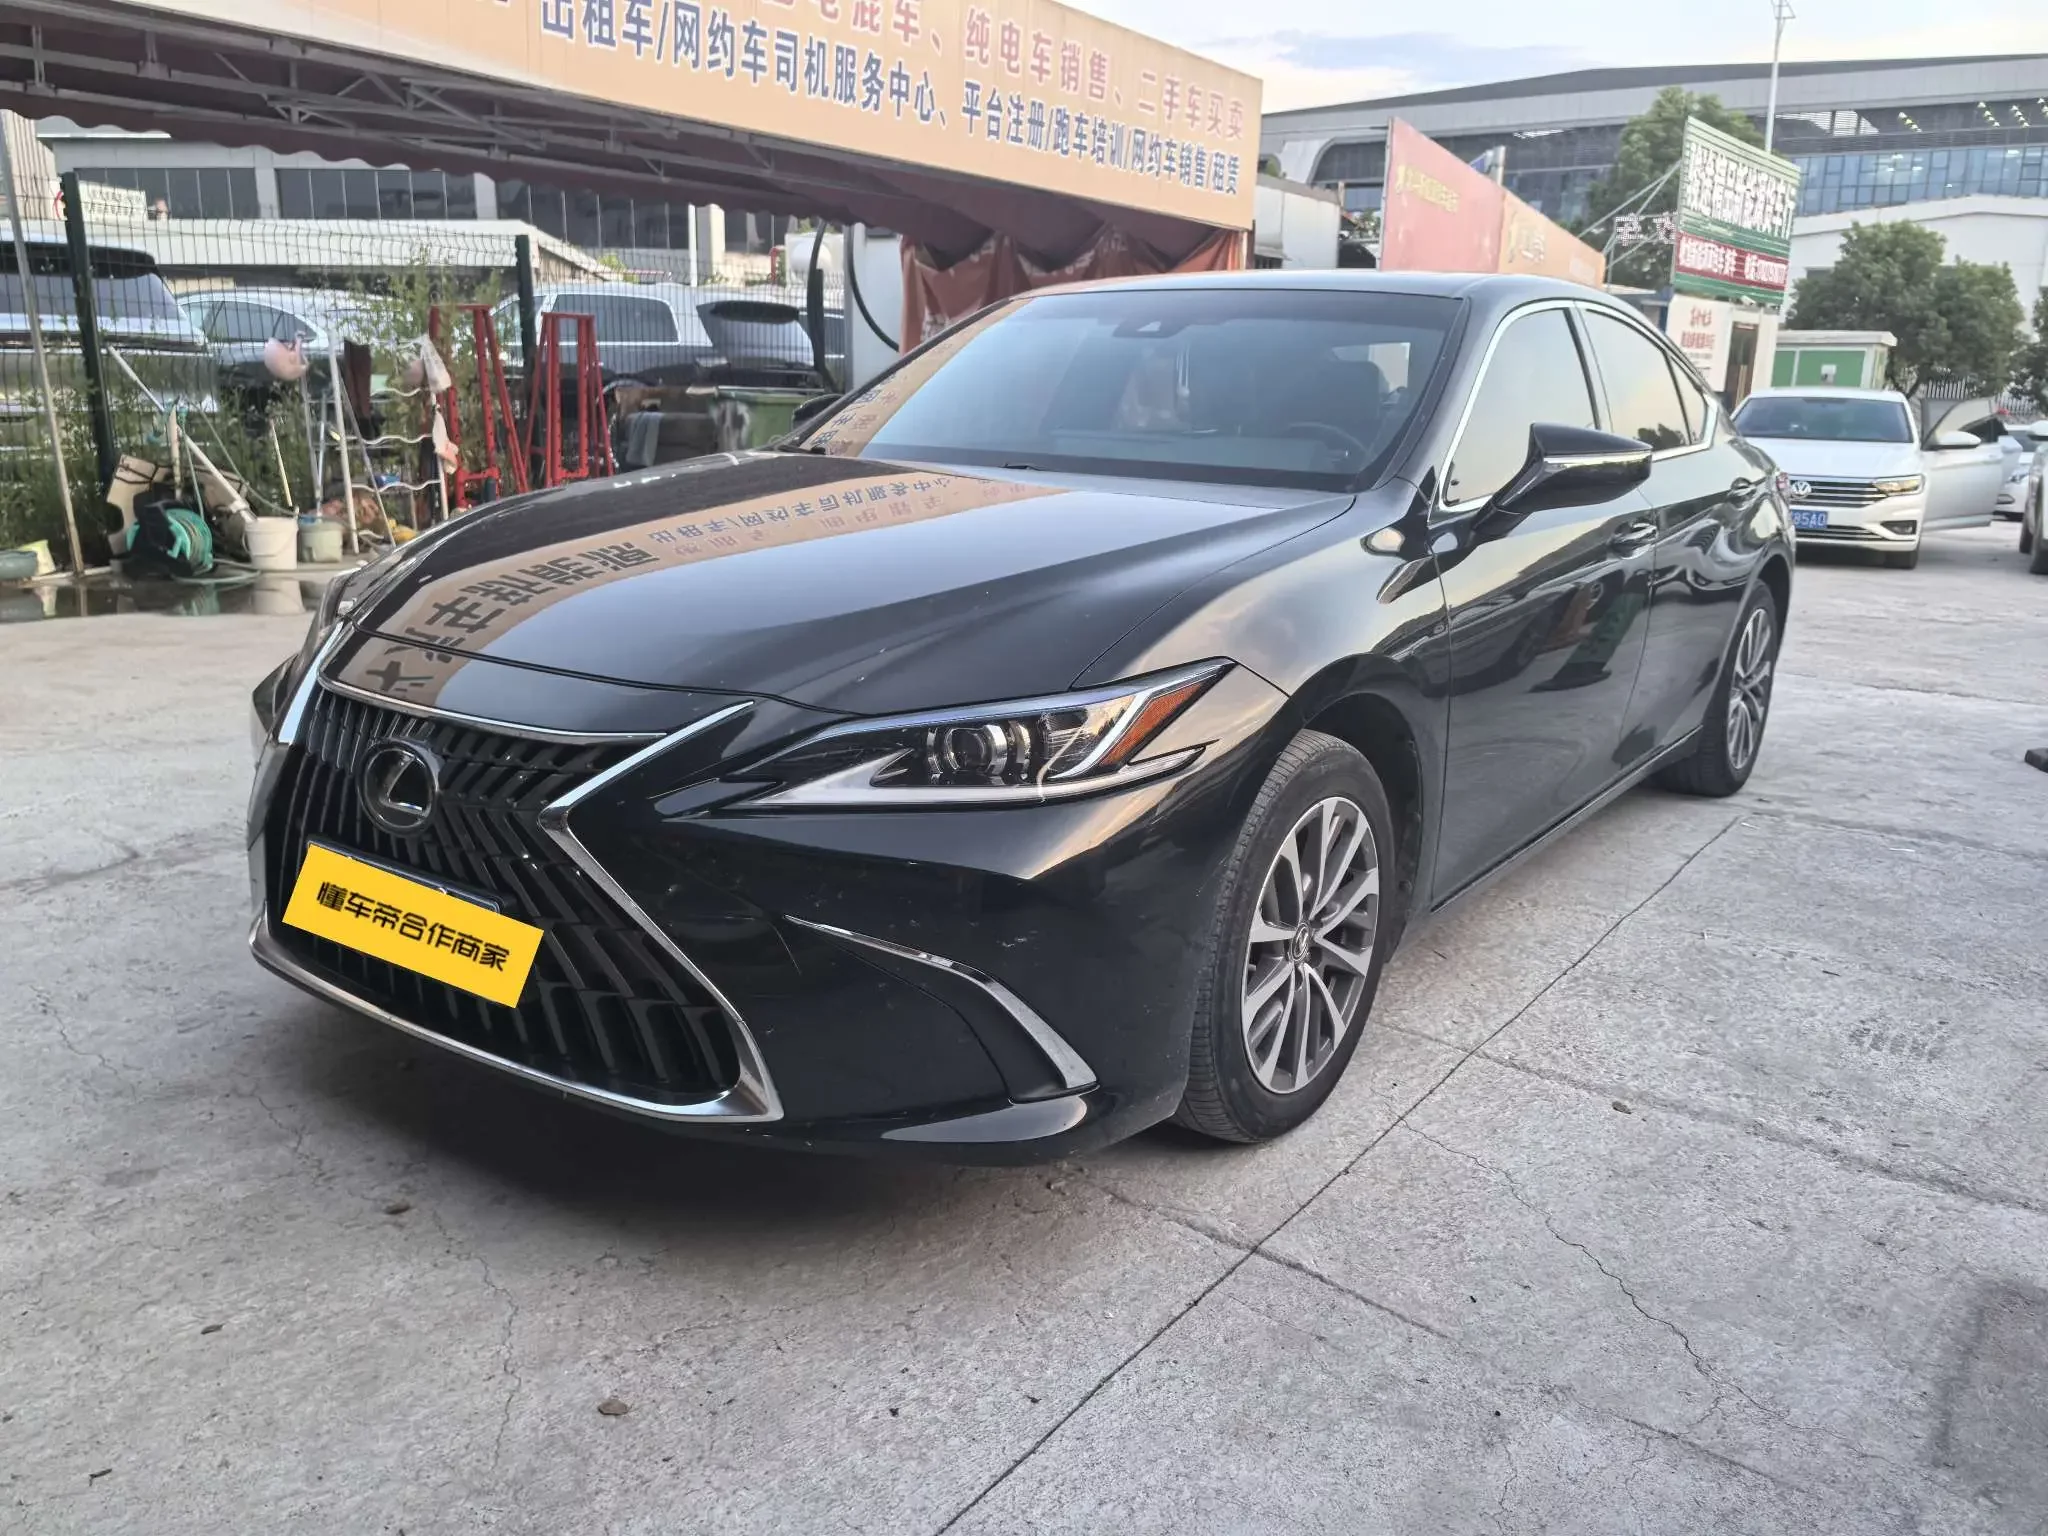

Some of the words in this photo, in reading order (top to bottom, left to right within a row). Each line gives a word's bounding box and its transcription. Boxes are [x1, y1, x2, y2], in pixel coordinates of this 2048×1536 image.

[765, 0, 1244, 140] 混车、纯电车销售、二手车买卖
